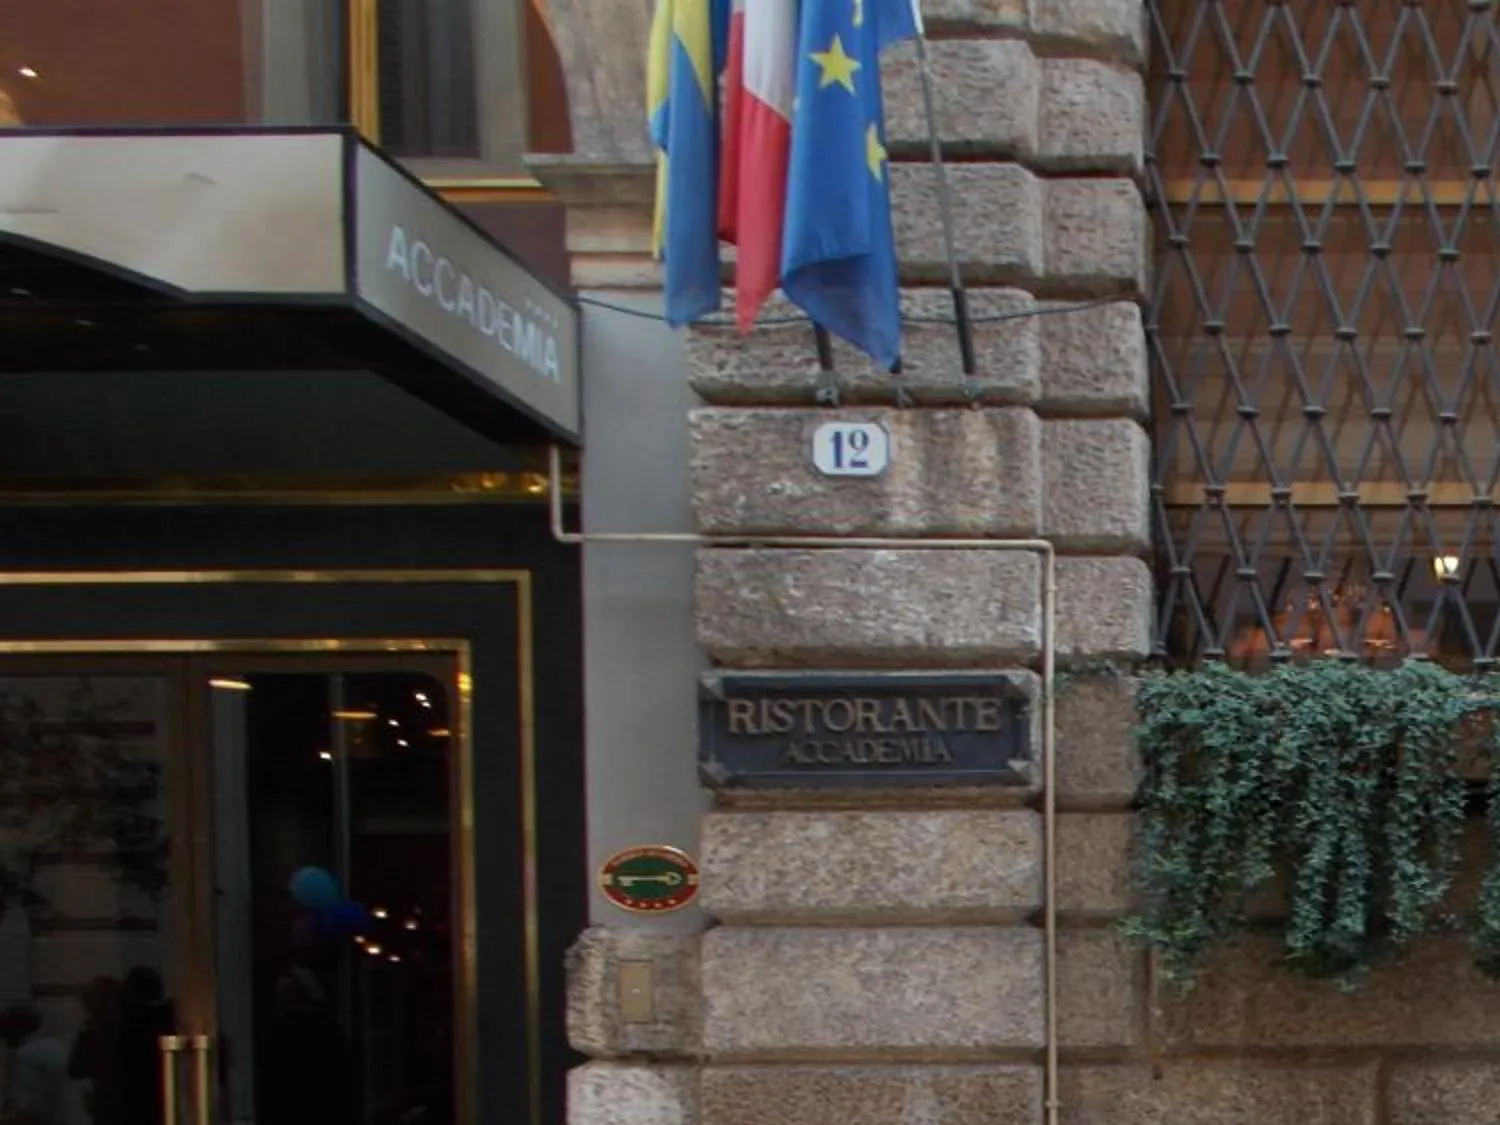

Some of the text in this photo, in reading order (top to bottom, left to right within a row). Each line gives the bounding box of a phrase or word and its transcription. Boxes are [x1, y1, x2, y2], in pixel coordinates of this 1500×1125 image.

[386, 225, 561, 384] ACCADEMIA
[831, 429, 869, 469] 12
[727, 698, 1001, 734] RISTORANTE
[786, 738, 952, 764] ACCADEMIA
